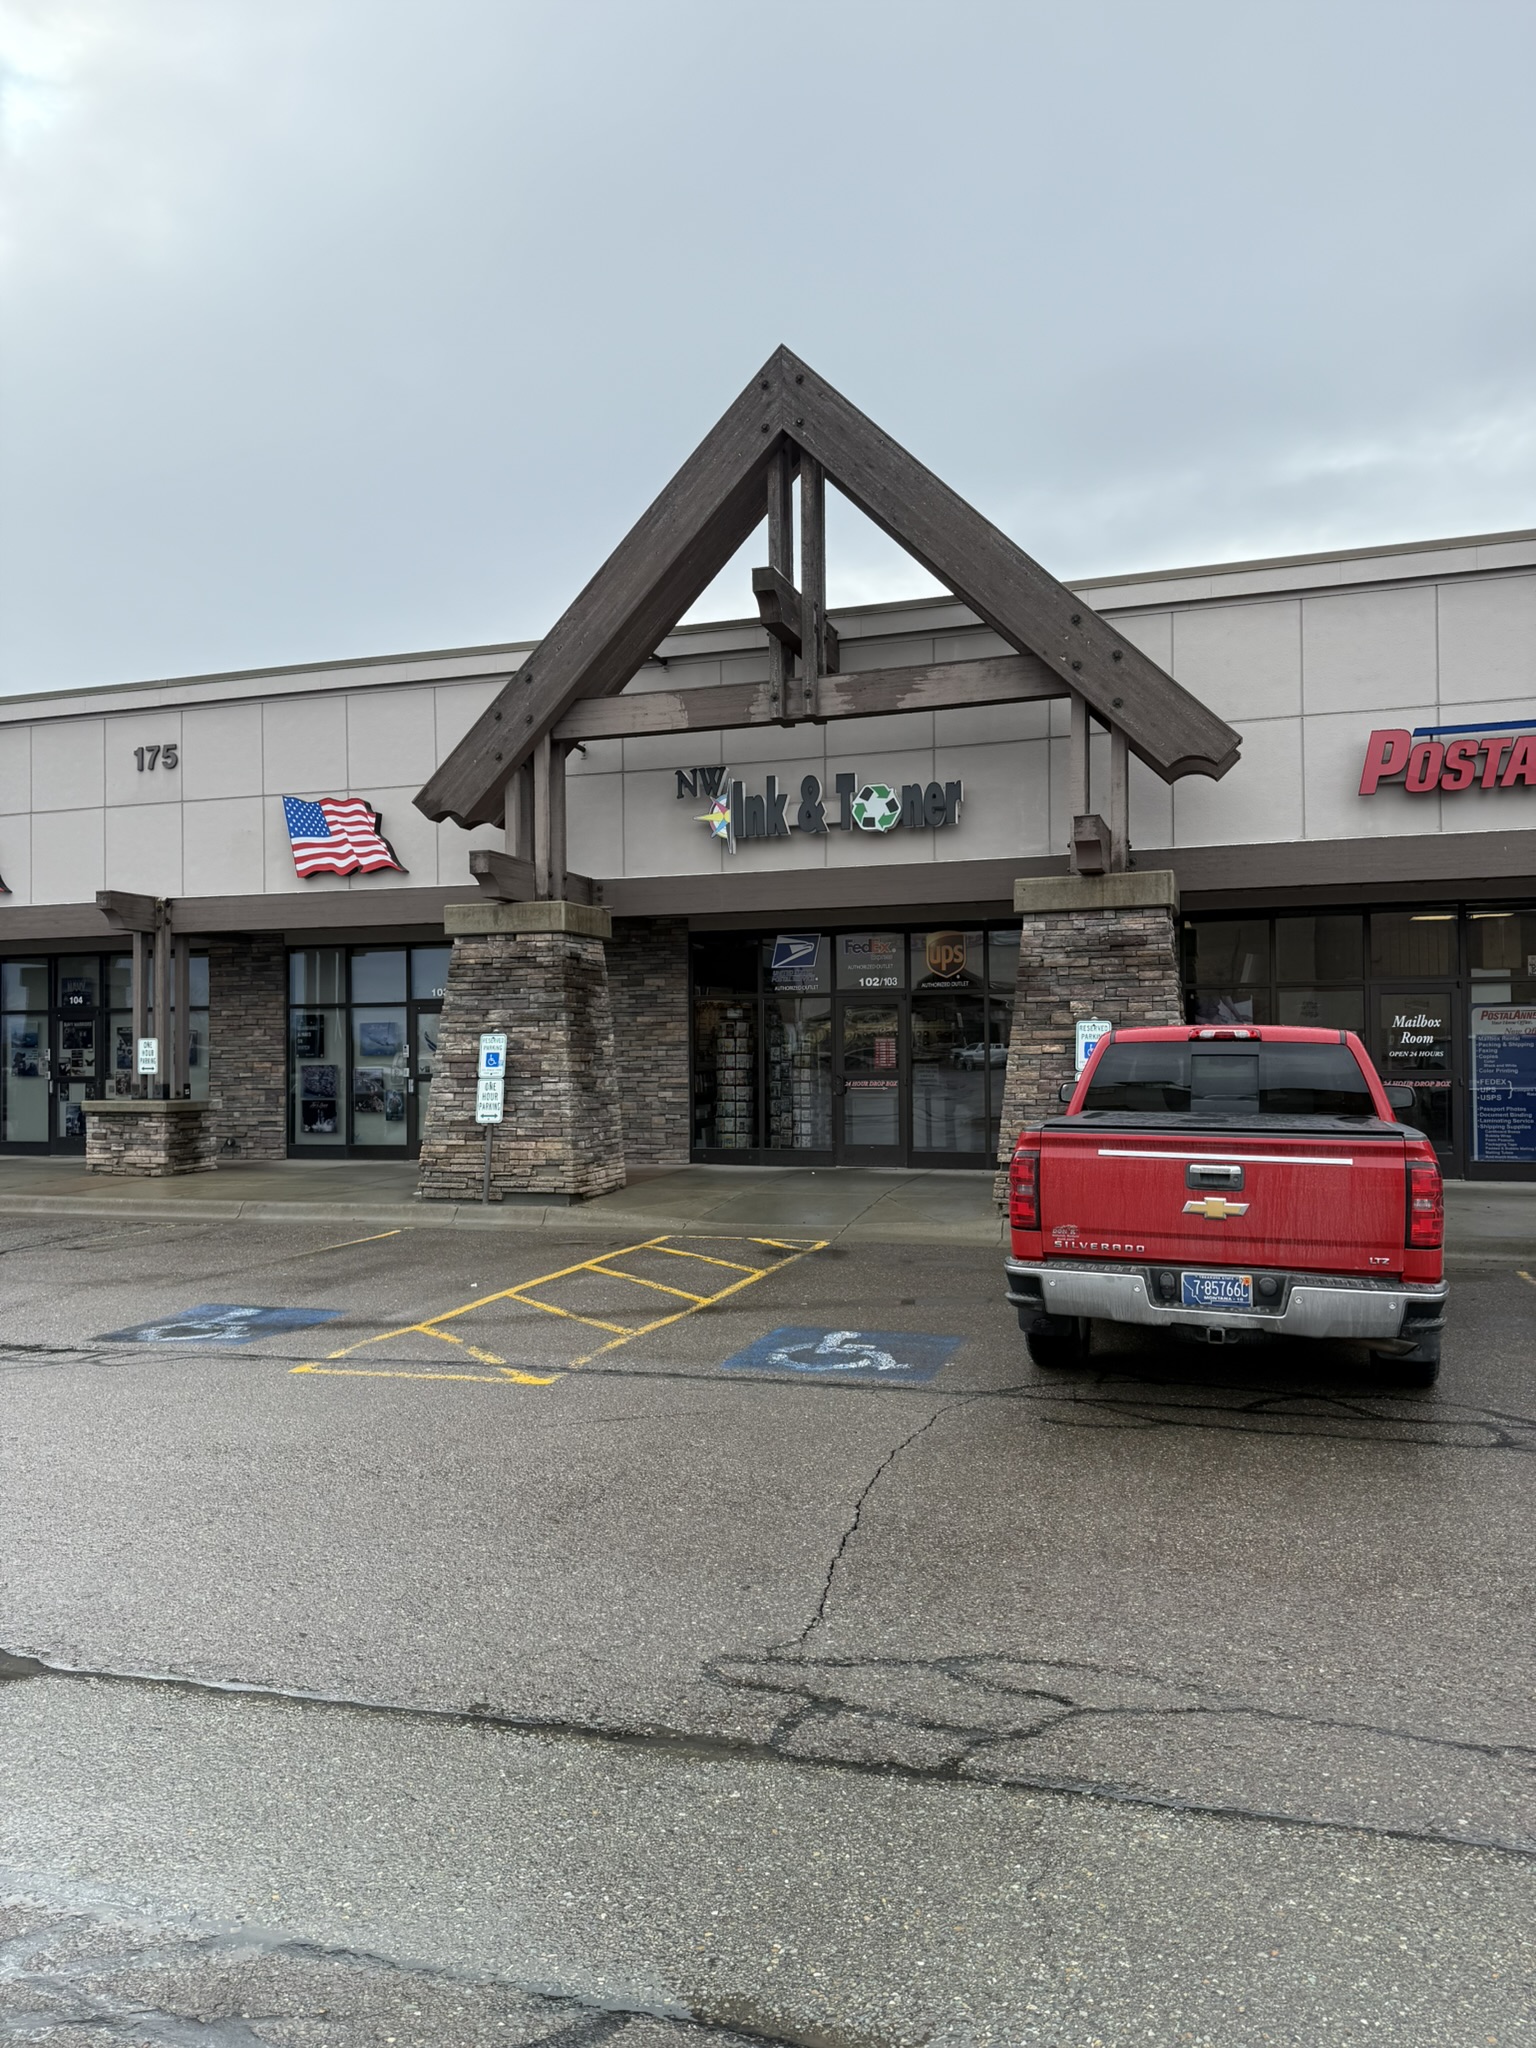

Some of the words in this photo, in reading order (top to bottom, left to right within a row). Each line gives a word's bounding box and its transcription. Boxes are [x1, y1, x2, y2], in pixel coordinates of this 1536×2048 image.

[134, 744, 179, 772] 175
[675, 766, 729, 799] NW
[733, 776, 791, 839] Ink
[798, 774, 830, 834] &
[844, 938, 890, 954] FedEx
[930, 944, 964, 971] ups
[859, 977, 898, 987] 102/103
[69, 996, 83, 1004] 104
[1392, 1014, 1441, 1028] Mailbox
[1401, 1031, 1434, 1044] Room
[485, 1082, 496, 1091] ONE
[482, 1093, 498, 1101] HOUR
[1054, 1241, 1145, 1253] SILVERADO
[1370, 1257, 1390, 1265] LTZ
